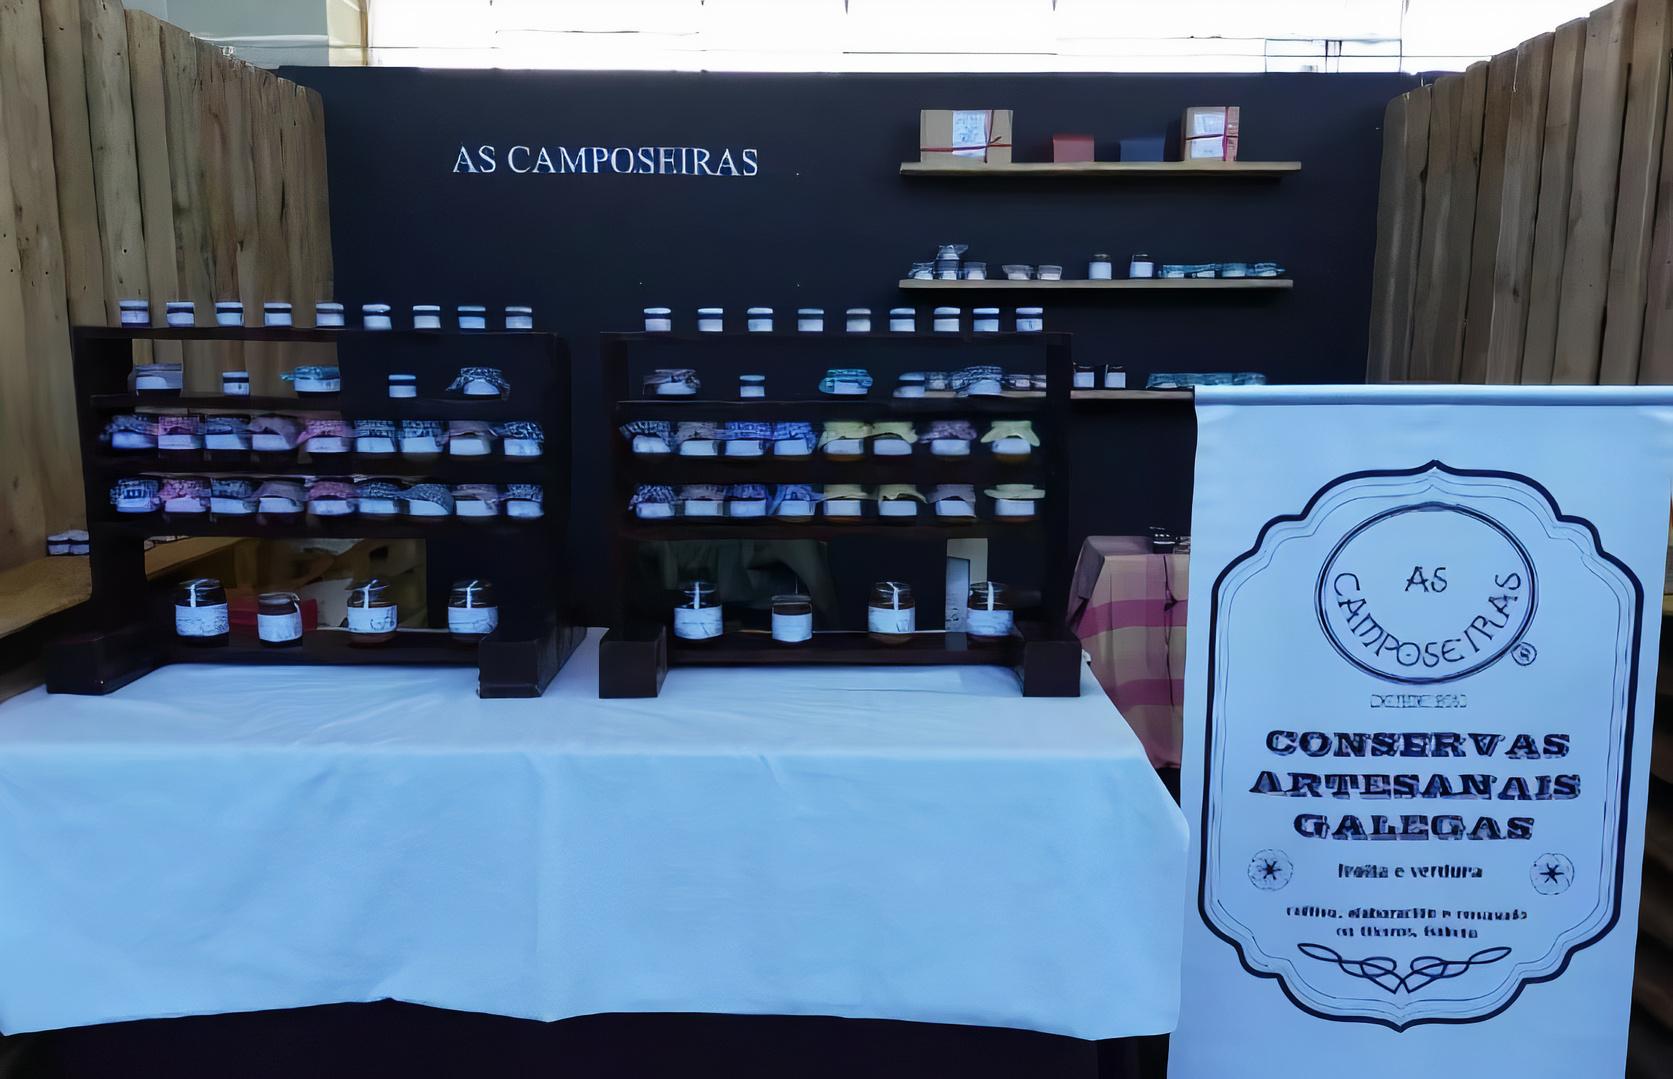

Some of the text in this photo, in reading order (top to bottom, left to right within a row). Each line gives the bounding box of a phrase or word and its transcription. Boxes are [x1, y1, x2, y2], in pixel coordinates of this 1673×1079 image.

[453, 145, 758, 176] AS CAMPOSEIRAS
[1405, 566, 1448, 593] AS
[1334, 572, 1521, 667] CAMPOSEIRAS
[1266, 730, 1571, 760] CONSERVAS
[1249, 771, 1582, 800] ARTESANAIS
[1293, 814, 1535, 840] GALEGAS
